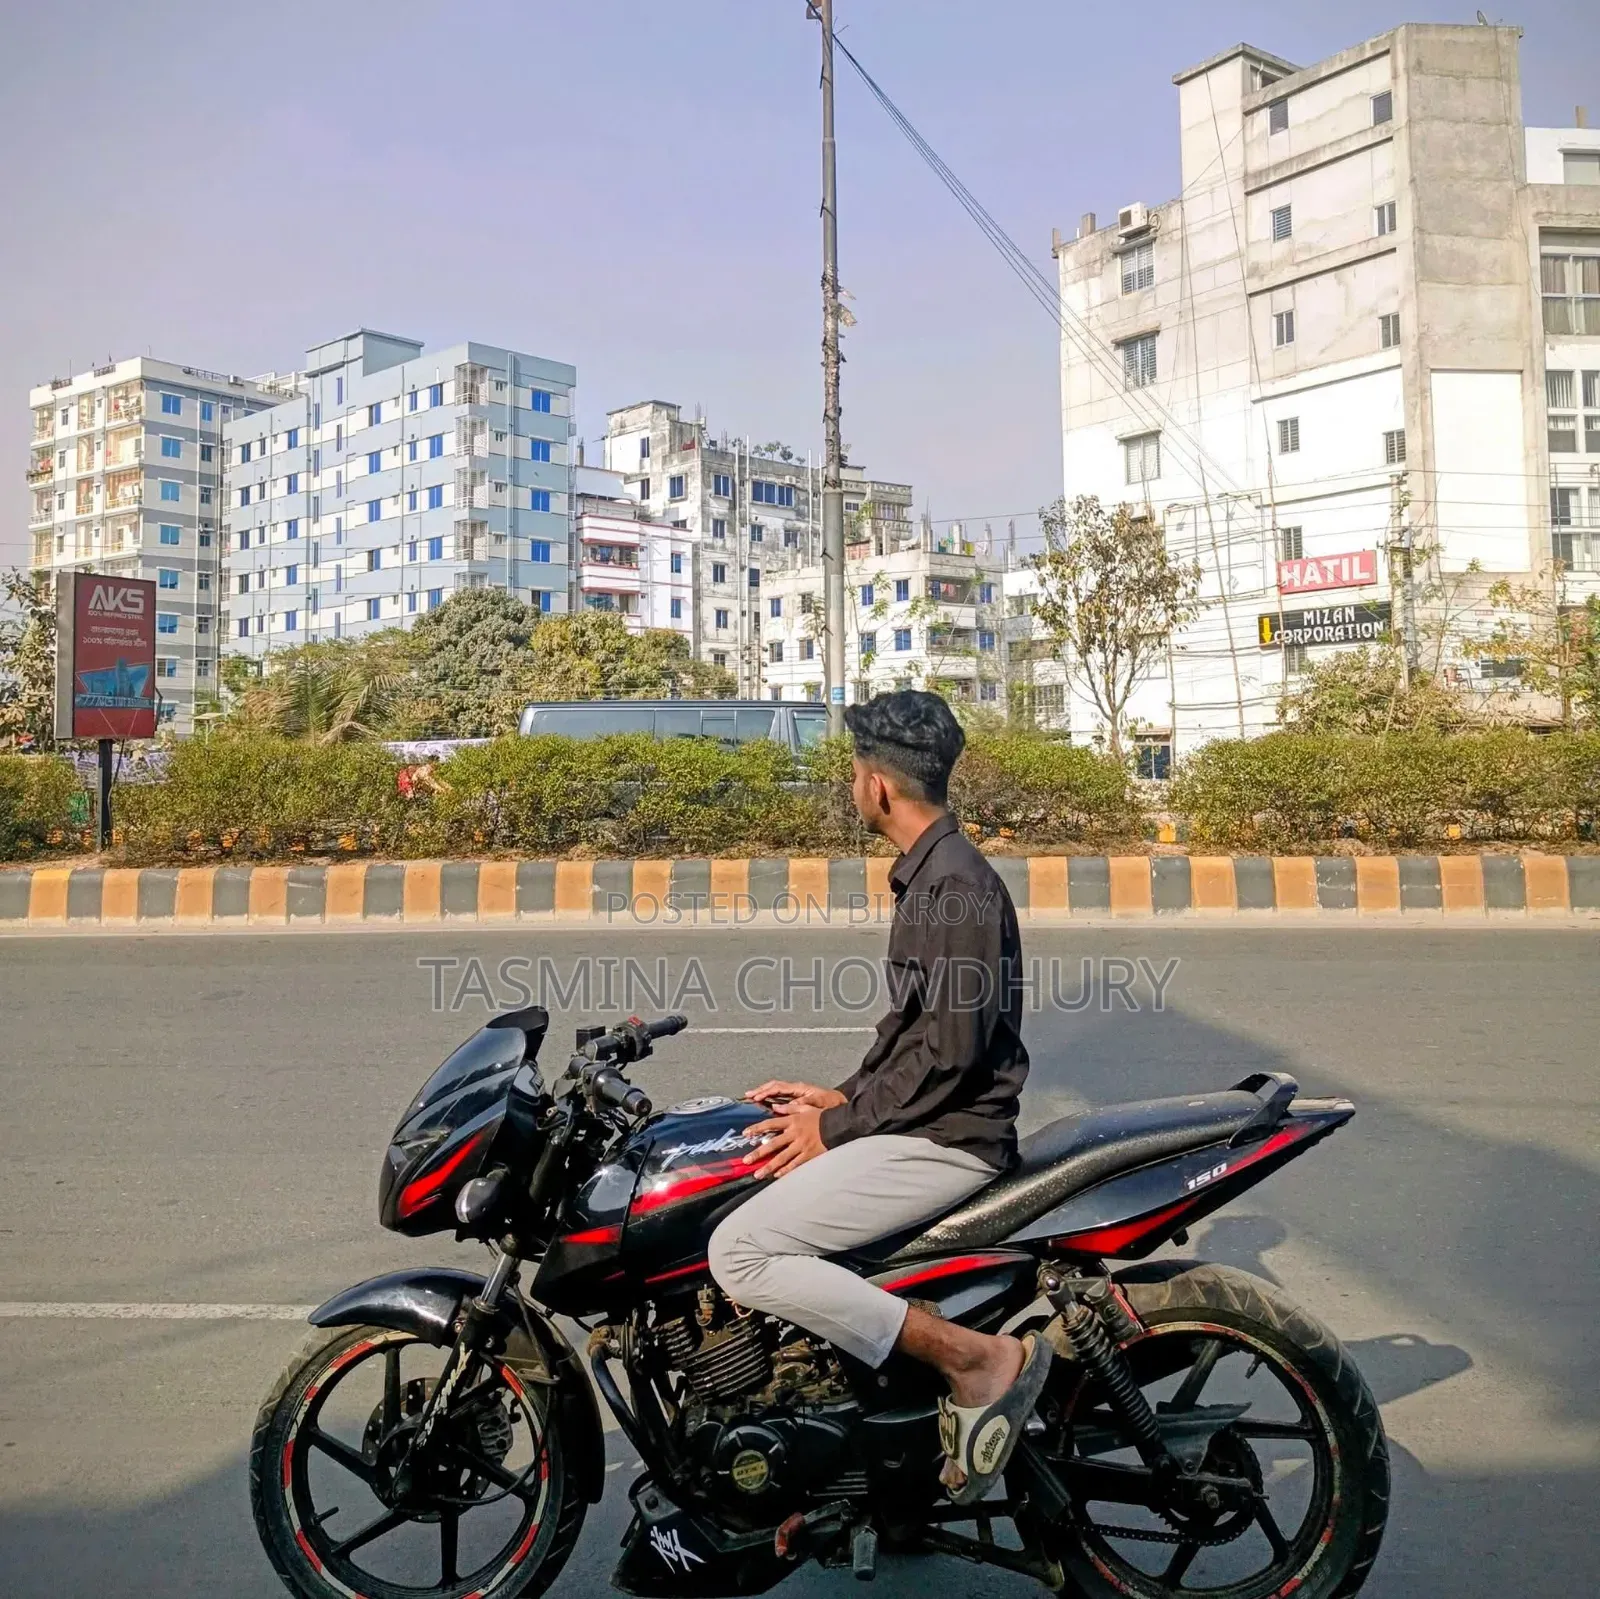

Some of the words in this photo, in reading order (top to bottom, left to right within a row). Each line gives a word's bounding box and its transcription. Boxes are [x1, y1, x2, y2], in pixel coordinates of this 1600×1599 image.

[1281, 557, 1370, 587] HATIL
[88, 585, 144, 613] AKS
[1303, 605, 1355, 626] MIZAN
[1274, 620, 1385, 645] CORPORATION
[1187, 1162, 1227, 1190] 150
